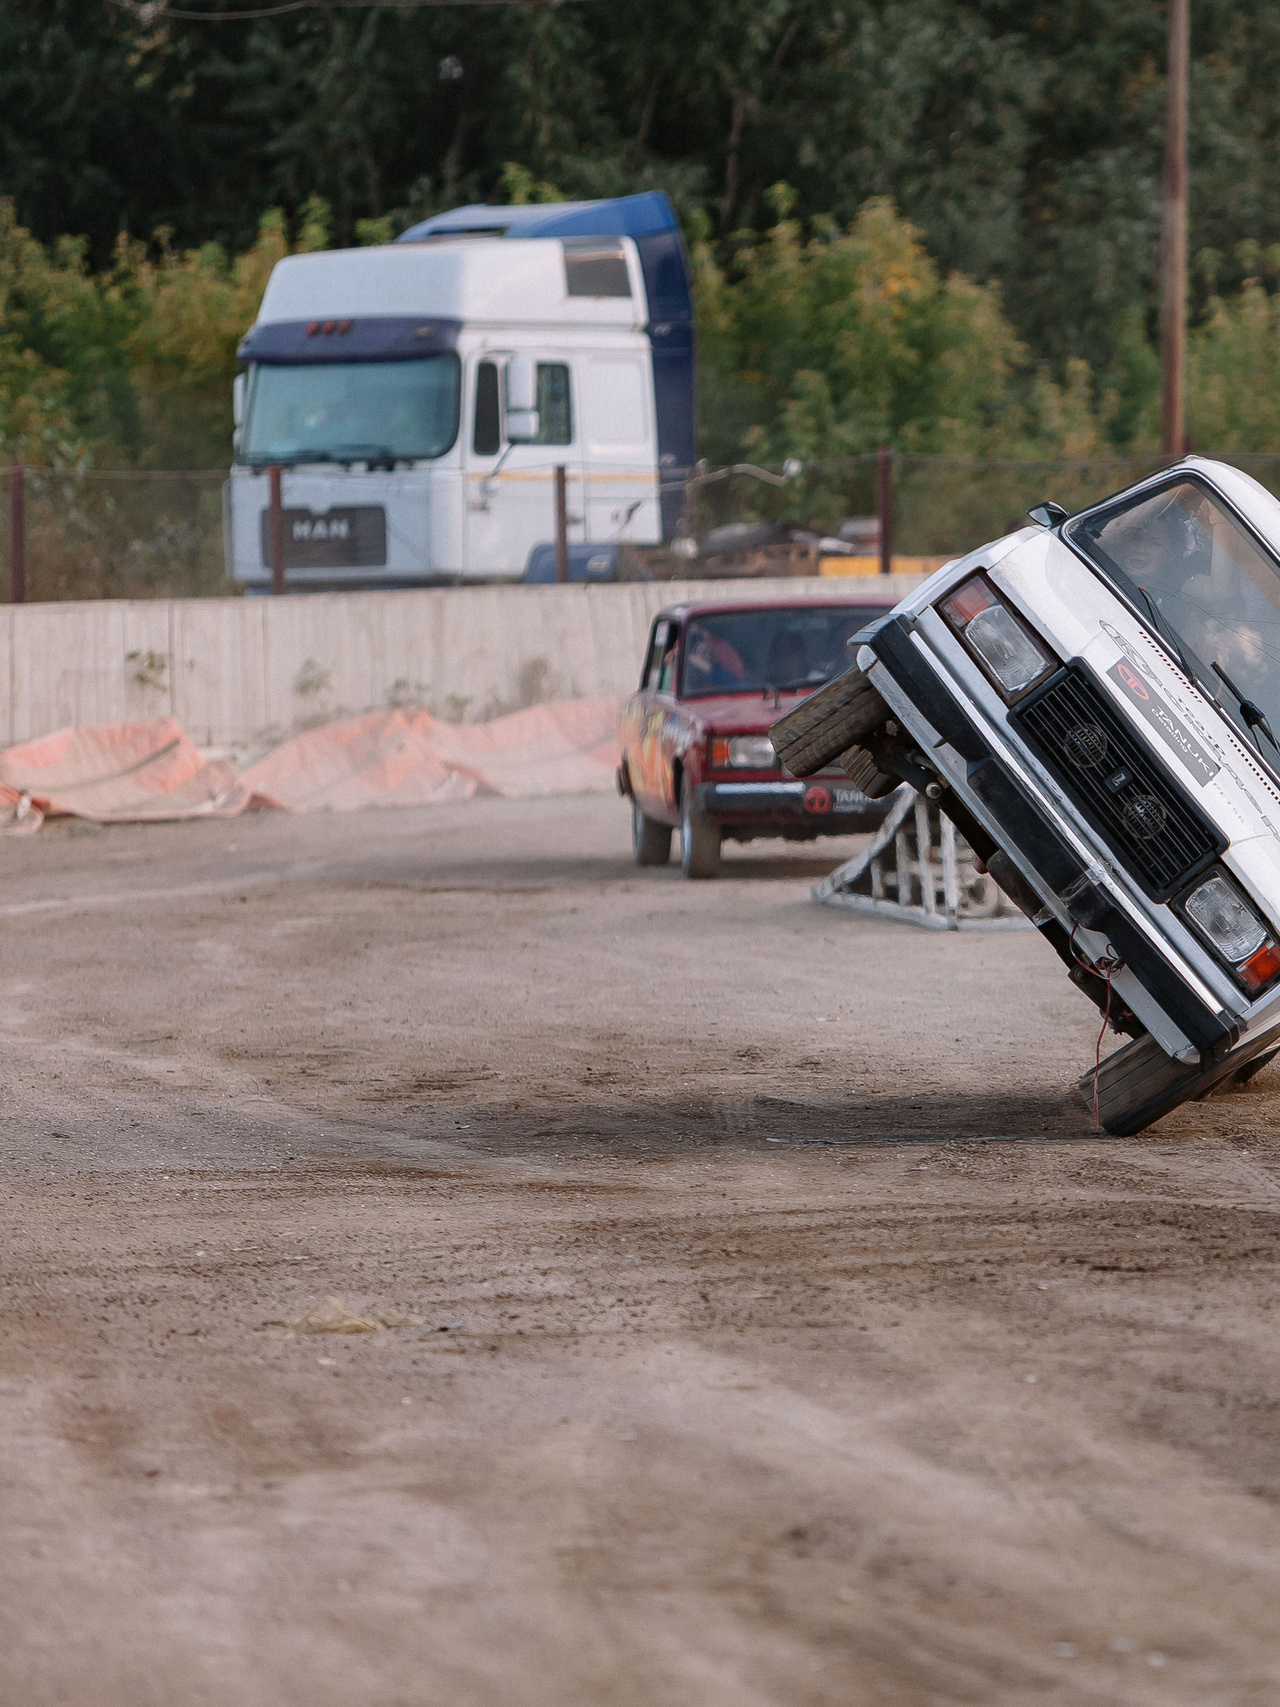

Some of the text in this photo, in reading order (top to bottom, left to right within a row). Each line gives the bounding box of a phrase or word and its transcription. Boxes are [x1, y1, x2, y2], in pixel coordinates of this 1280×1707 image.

[292, 519, 349, 540] MAN
[1150, 707, 1188, 754] Detailing
[1156, 705, 1215, 777] TANUKI
